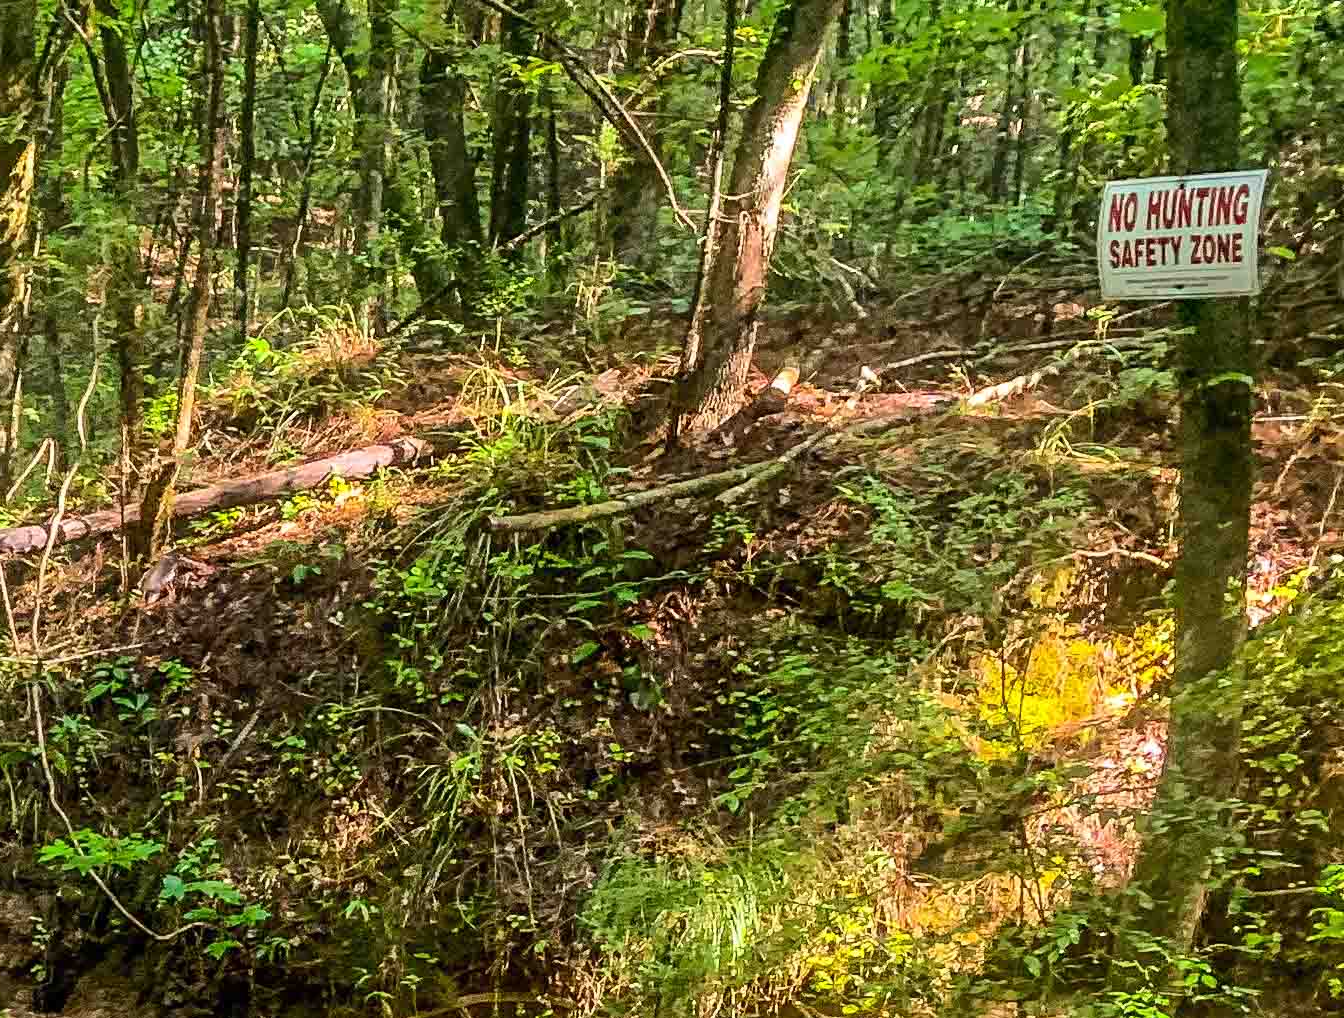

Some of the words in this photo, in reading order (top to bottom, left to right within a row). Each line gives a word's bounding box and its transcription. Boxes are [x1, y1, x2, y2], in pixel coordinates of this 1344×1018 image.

[1108, 192, 1138, 233] NO
[1146, 184, 1250, 231] HUNTING
[1109, 235, 1182, 269] SAFETY
[1190, 232, 1243, 265] ZONE
